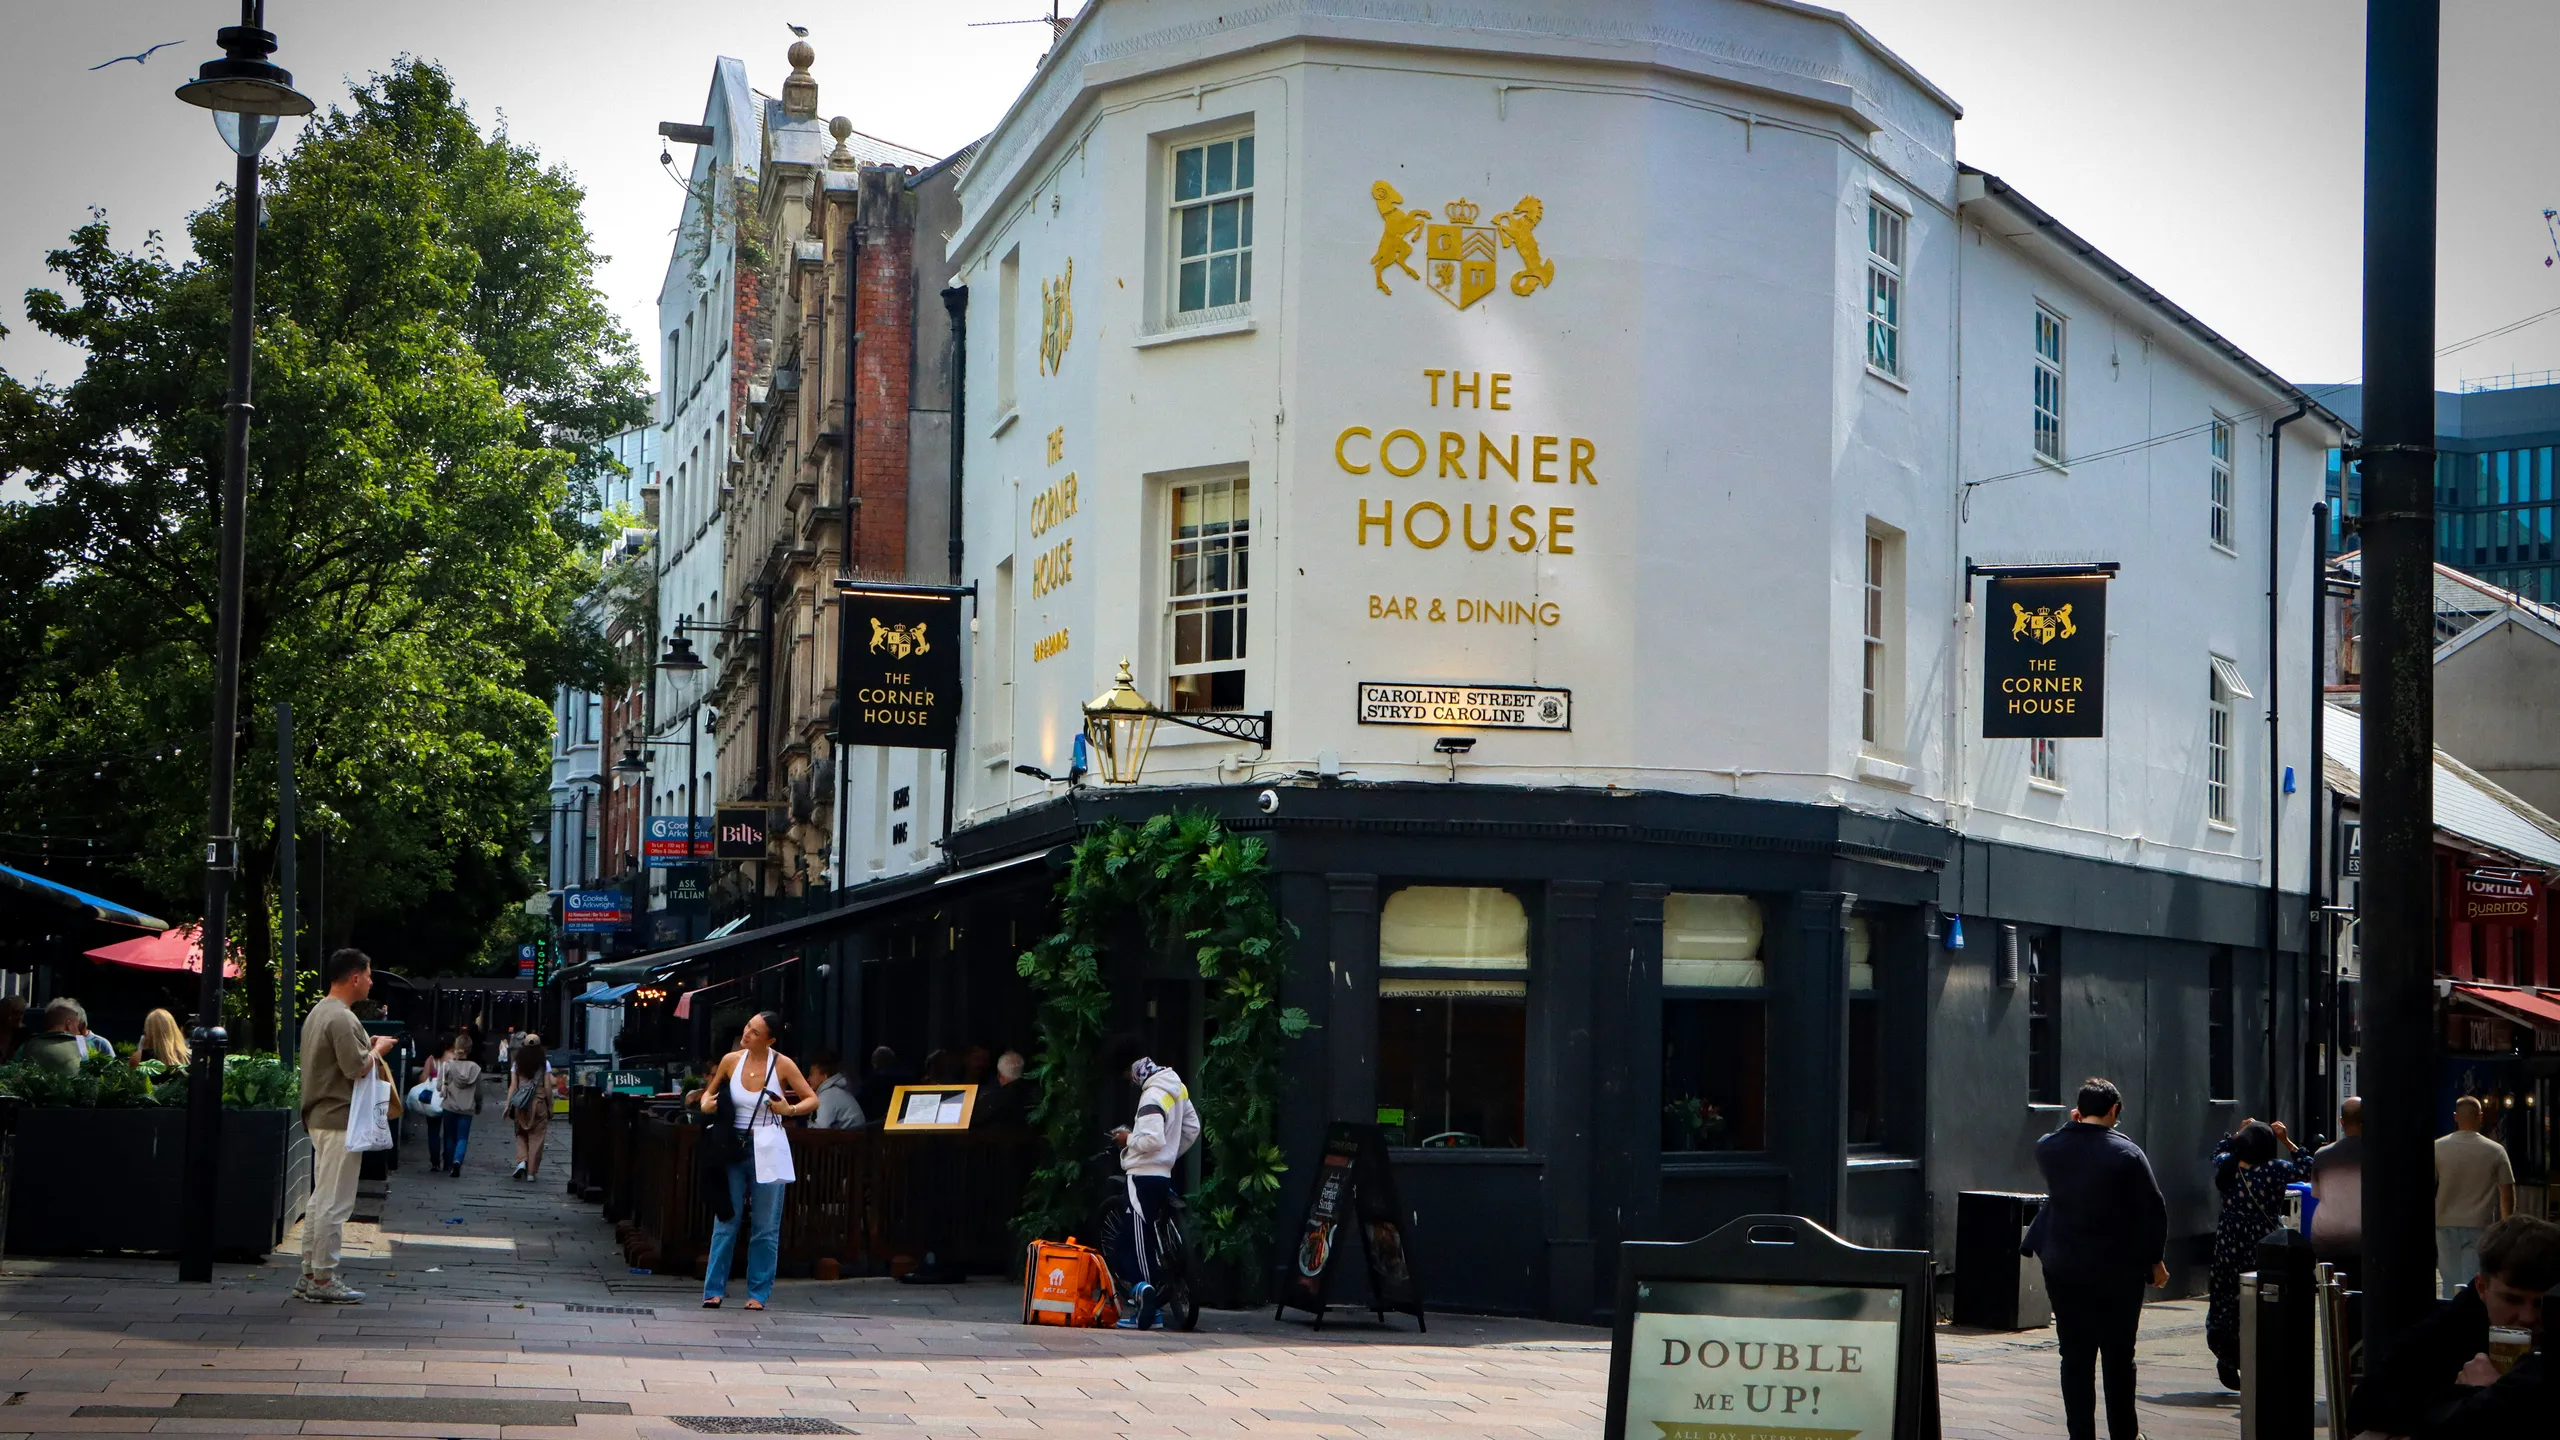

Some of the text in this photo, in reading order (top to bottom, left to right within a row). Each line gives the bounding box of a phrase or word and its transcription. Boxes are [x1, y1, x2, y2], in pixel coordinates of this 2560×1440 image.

[1424, 369, 1511, 410] THE
[1047, 425, 1064, 467] THE
[1335, 426, 1598, 484] CORNER
[1031, 471, 1078, 538] CORNER
[1358, 498, 1574, 554] HOUSE
[1033, 537, 1073, 599] HOUSE
[1369, 595, 1560, 626] BAR & DINING
[2029, 660, 2057, 671] THE
[885, 672, 911, 684] THE
[2002, 677, 2083, 693] CORNER
[858, 688, 935, 706] CORNER
[1367, 688, 1536, 708] CAROLINE STREET
[1367, 705, 1427, 719] STRYD
[1433, 707, 1525, 723] CAROLINE
[2008, 698, 2076, 714] HOUSE
[864, 709, 928, 726] HOUSE
[668, 829, 708, 839] Arkwght
[722, 823, 763, 845] Bill's
[679, 880, 696, 888] ASK
[669, 891, 704, 899] ITALIAN
[582, 901, 615, 909] Arkwright
[2468, 902, 2528, 918] BURRITOS
[2311, 912, 2318, 921] 2
[615, 1073, 641, 1086] Bill's
[1660, 1338, 1862, 1373] DOUBLE
[1693, 1384, 1821, 1415] ME UP!
[1674, 1431, 1701, 1440] ALL
